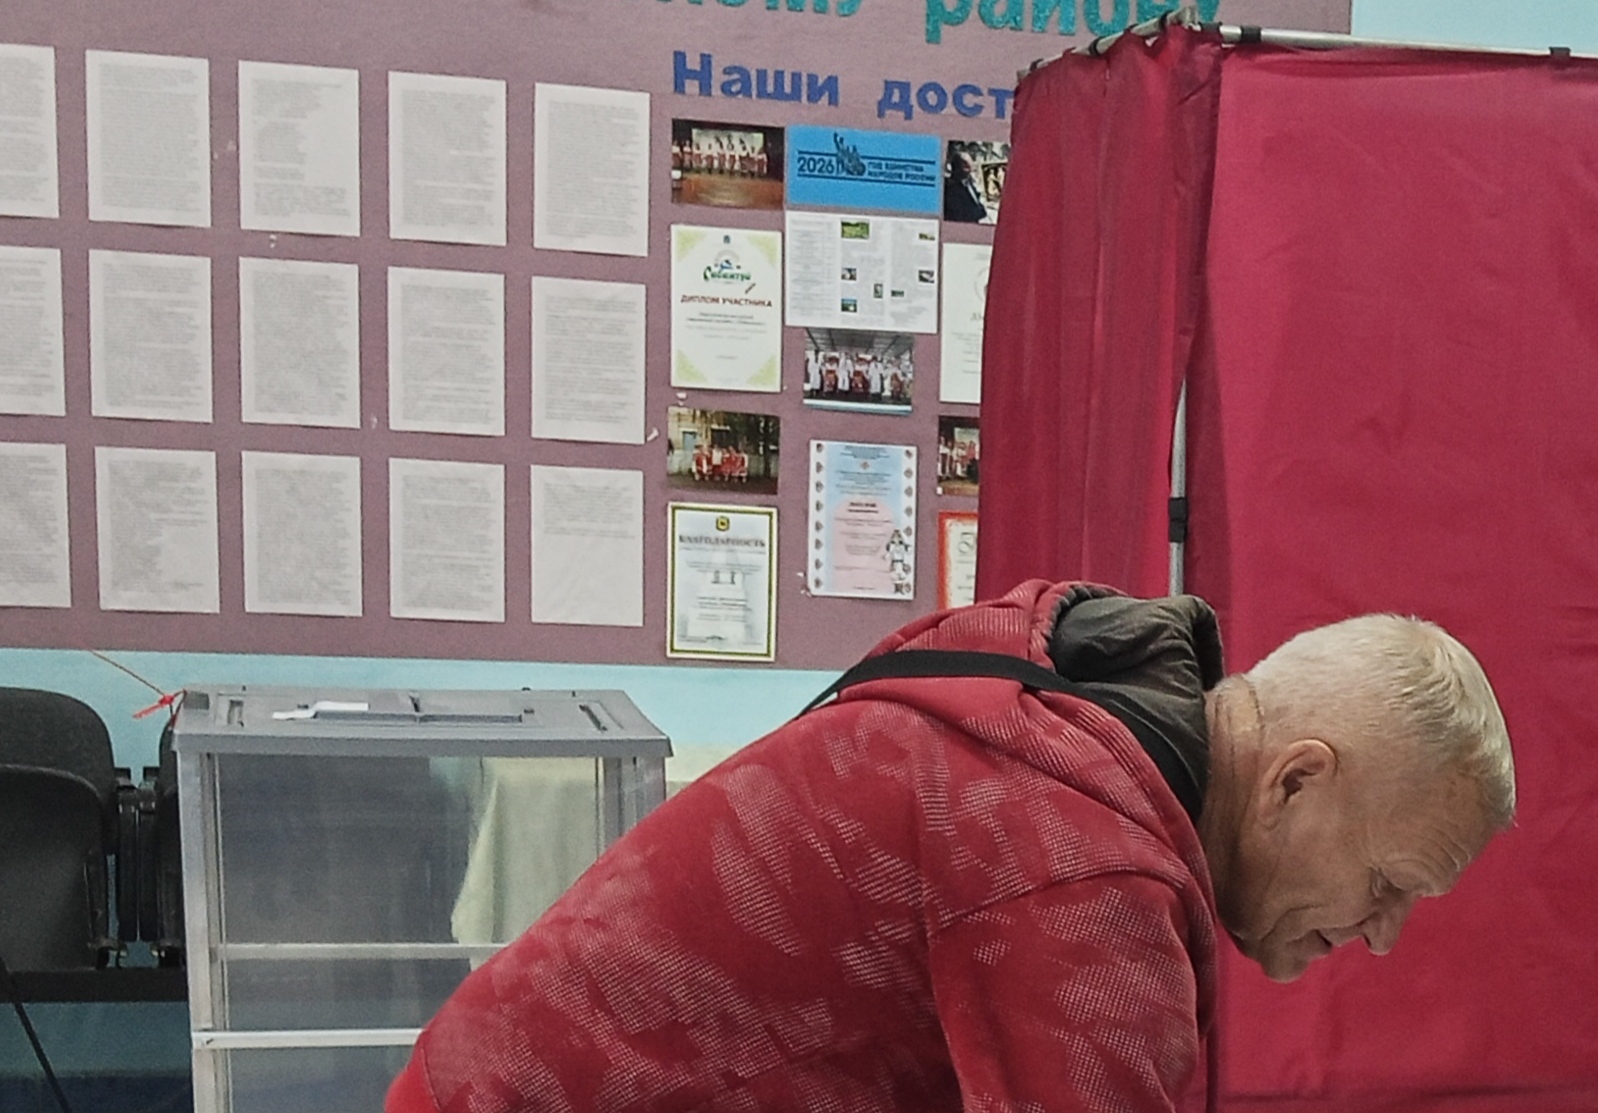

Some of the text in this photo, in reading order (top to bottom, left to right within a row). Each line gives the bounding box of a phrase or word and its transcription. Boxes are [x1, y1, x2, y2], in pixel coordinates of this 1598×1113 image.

[672, 50, 840, 107] Наши
[797, 156, 835, 174] 2026
[681, 294, 773, 307] ДИПЛОМ УЧАСТНИКА
